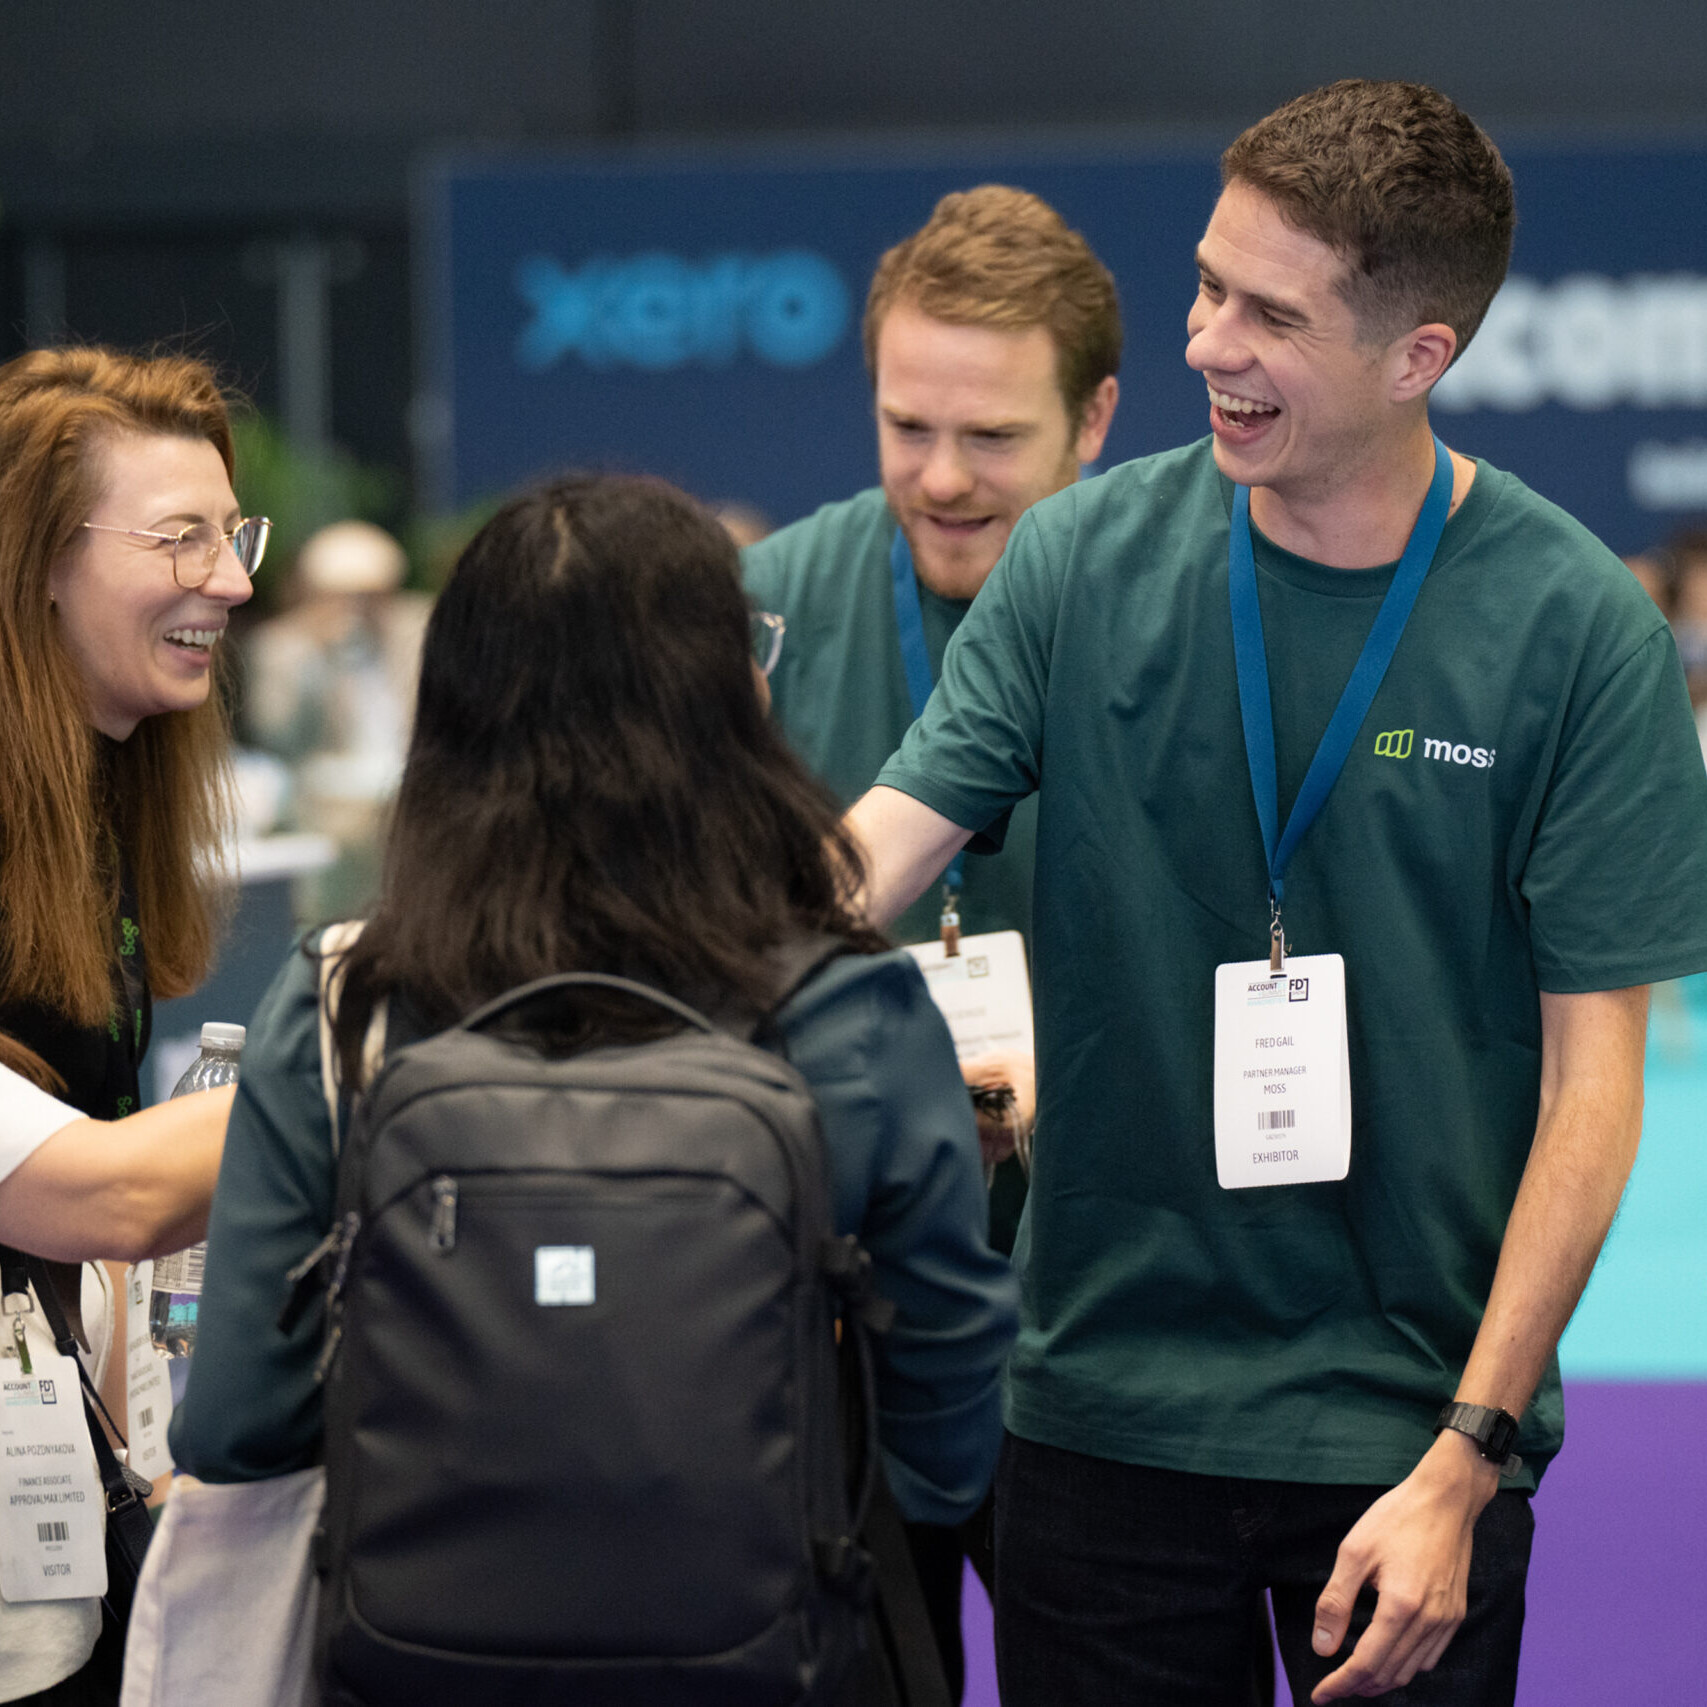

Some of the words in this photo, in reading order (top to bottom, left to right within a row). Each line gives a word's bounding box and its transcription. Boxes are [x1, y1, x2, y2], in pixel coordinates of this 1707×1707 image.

[1424, 738, 1496, 768] moss
[1255, 1037, 1275, 1049] FRED
[1276, 1036, 1294, 1047] GAIL
[1243, 1068, 1273, 1079] PARTNER
[1274, 1065, 1307, 1076] MANAGER
[1263, 1083, 1287, 1095] MOSS
[1252, 1149, 1299, 1164] EXHIBITOR
[18, 1476, 42, 1487] FINANCE
[59, 1491, 86, 1504] LIMITED
[43, 1563, 71, 1576] VISITOR
